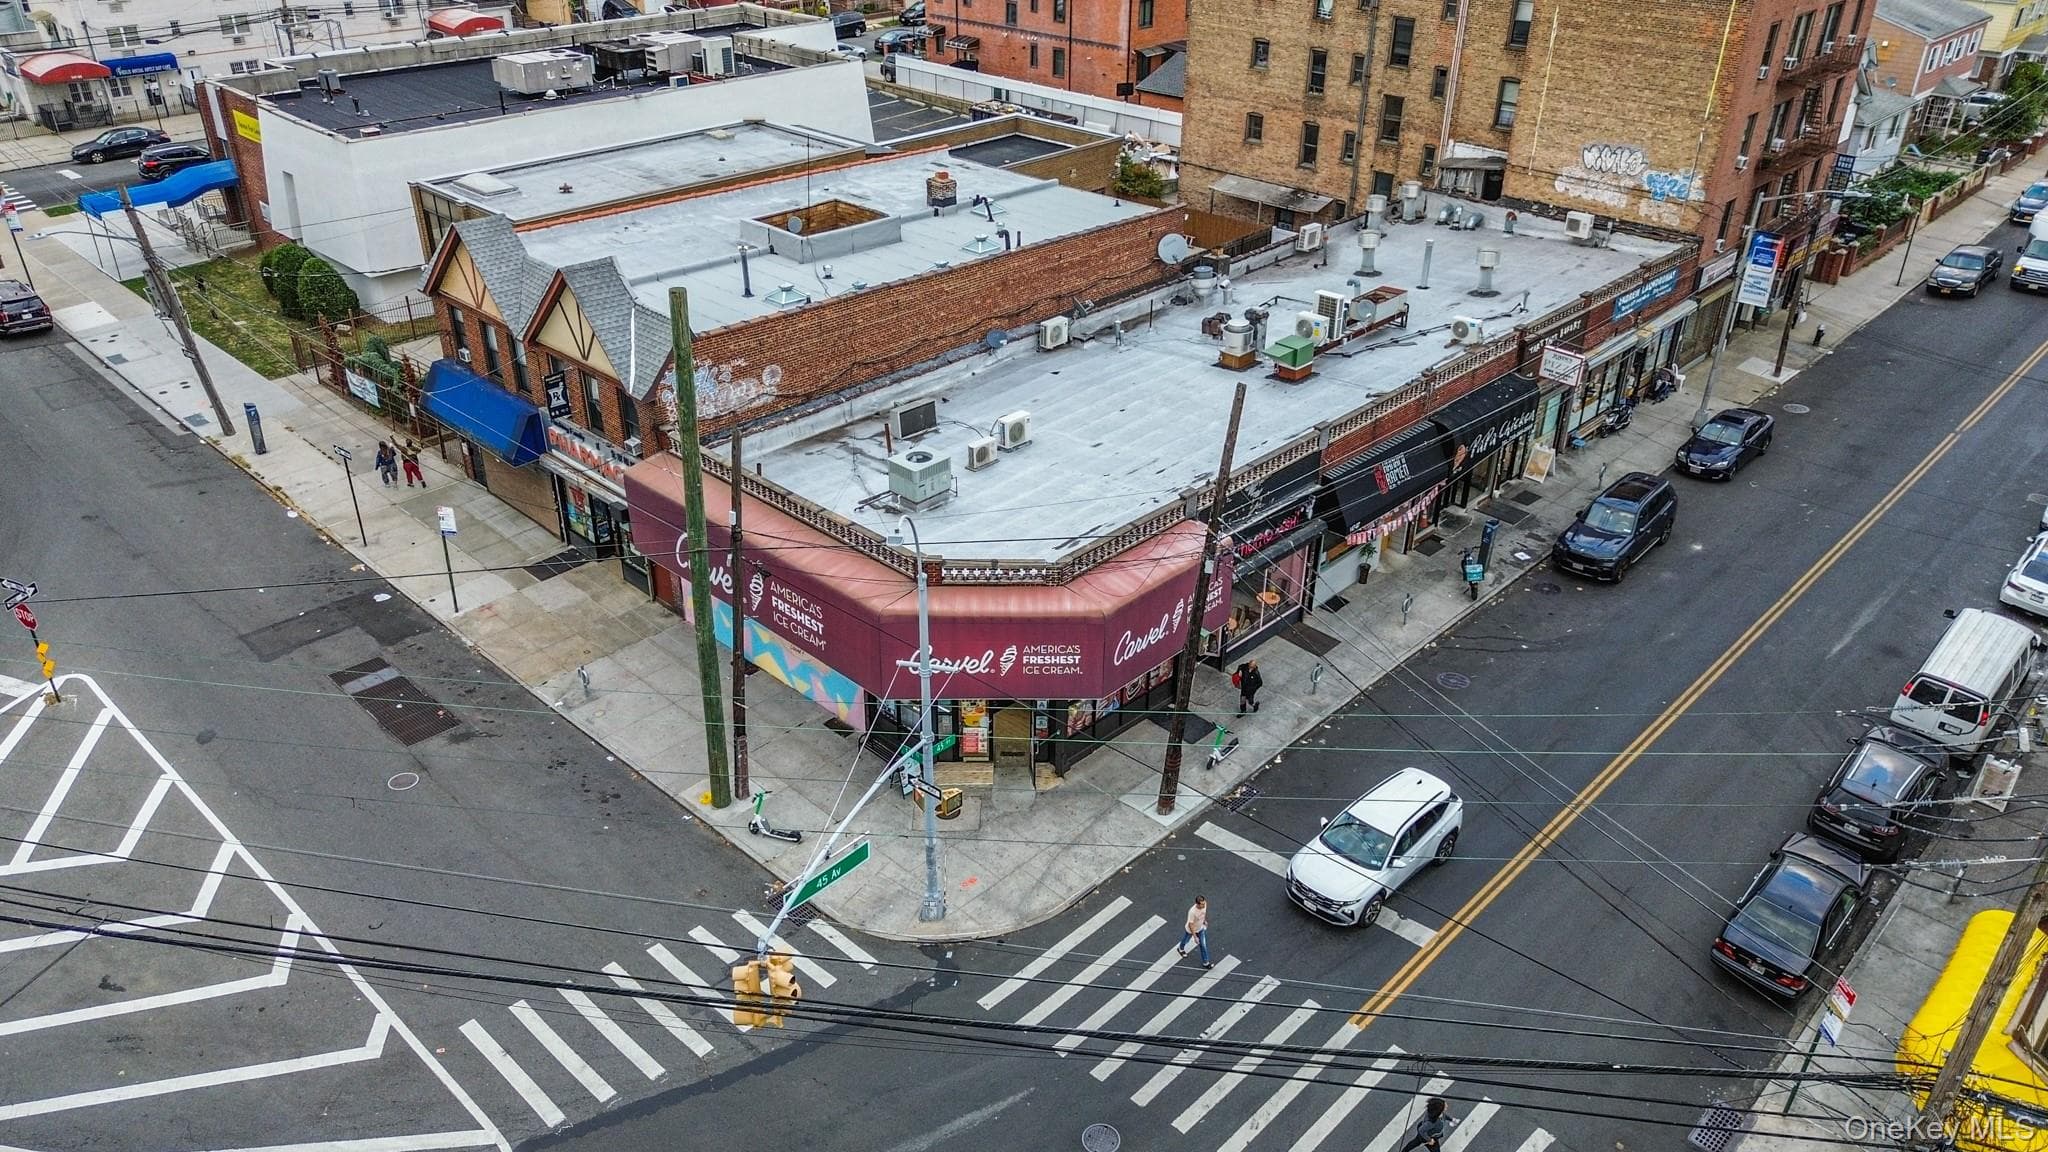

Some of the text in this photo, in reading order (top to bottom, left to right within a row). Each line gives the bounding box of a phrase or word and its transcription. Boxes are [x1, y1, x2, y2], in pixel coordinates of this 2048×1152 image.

[1559, 320, 1582, 338] BAKERY
[548, 428, 624, 481] PHARMAC
[1385, 463, 1410, 486] RAMEN
[675, 532, 734, 594] Cve
[770, 581, 823, 619] AMERICA'S
[15, 608, 34, 623] STOP
[771, 596, 824, 635] FRESHEST
[773, 612, 789, 629] ICE
[1022, 644, 1081, 654] AMERICA'S
[1113, 613, 1169, 666] Carvel
[1022, 655, 1081, 664] FRESHEST
[1022, 666, 1040, 675] ICE
[816, 867, 841, 888] 45 Av
